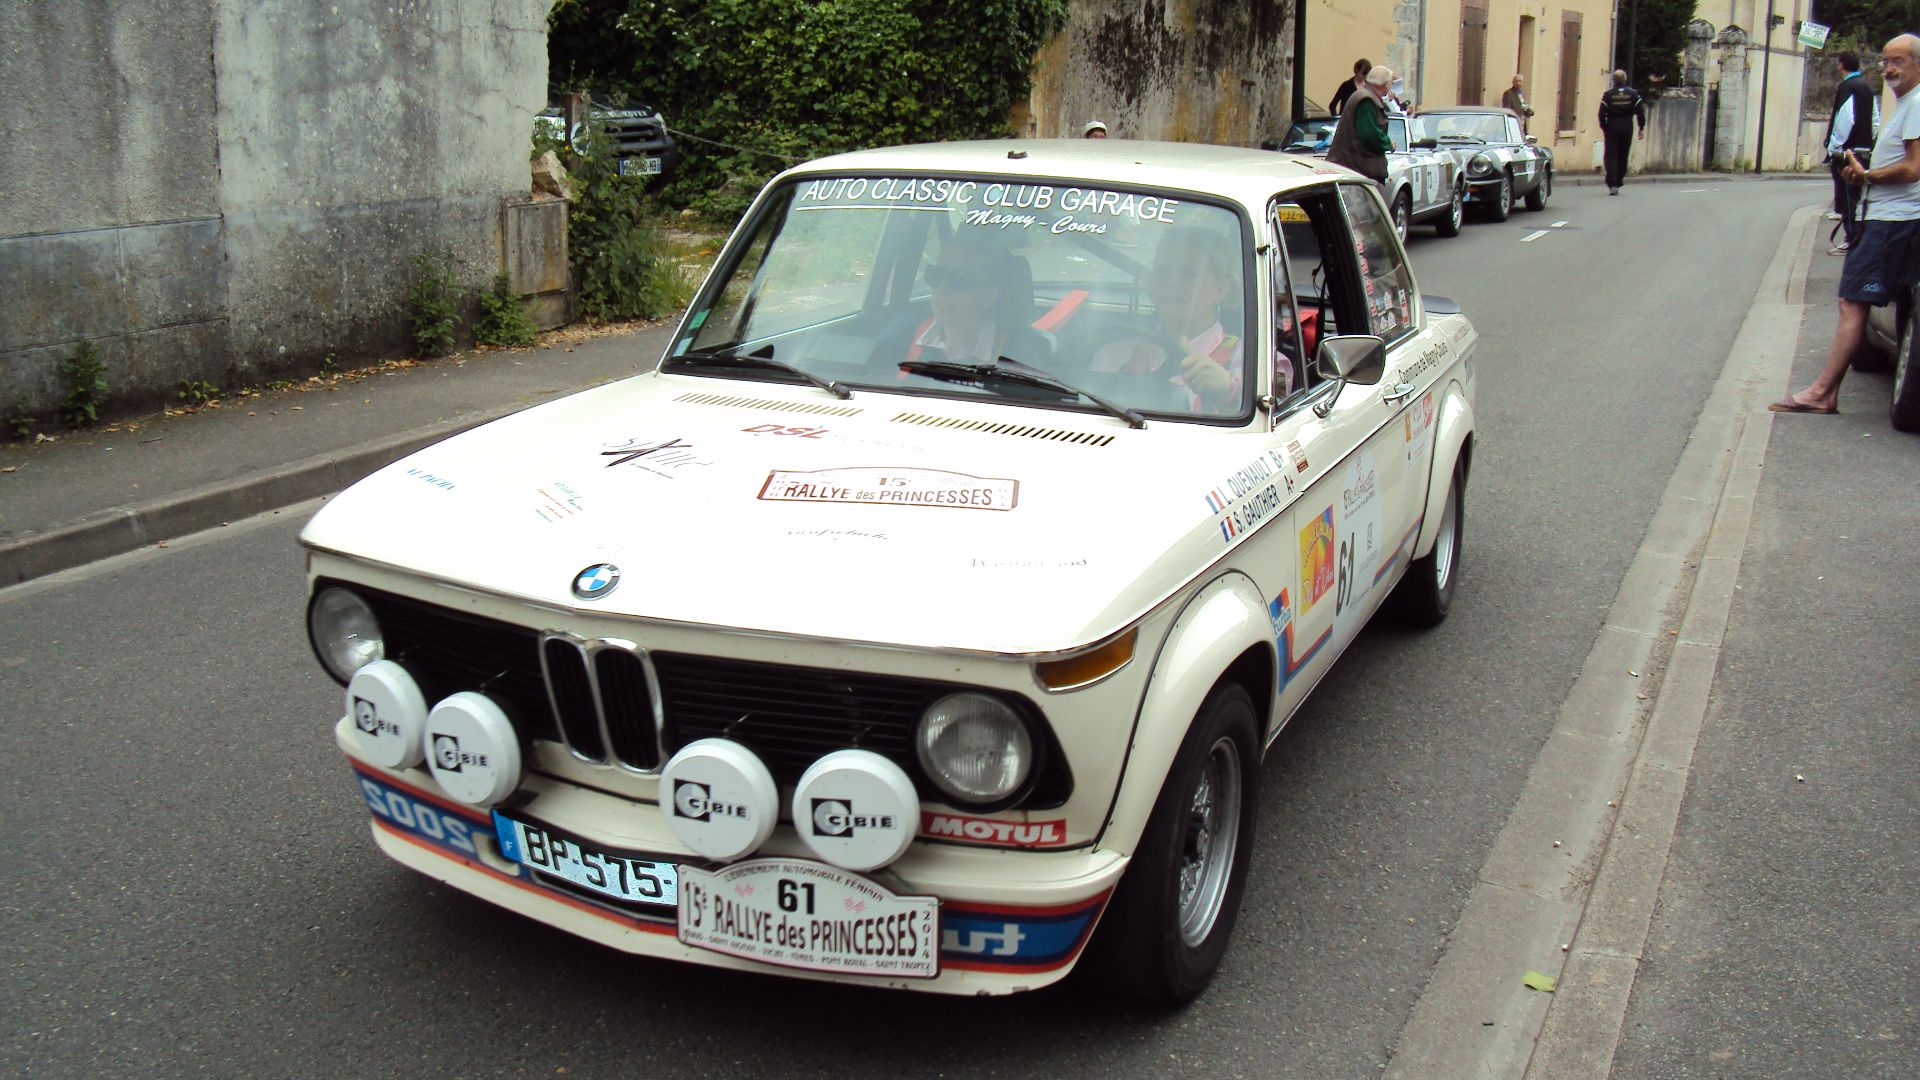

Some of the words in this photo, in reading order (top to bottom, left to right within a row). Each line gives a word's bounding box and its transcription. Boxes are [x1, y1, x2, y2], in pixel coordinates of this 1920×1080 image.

[801, 177, 868, 201] AUTO
[871, 178, 976, 204] CLASSIC
[983, 183, 1054, 209] CLUB
[1060, 187, 1179, 224] GARAGE
[965, 209, 1035, 230] Magny
[1050, 215, 1108, 235] Cours
[740, 423, 829, 439] DSL
[783, 481, 851, 500] RALLYE
[855, 490, 875, 501] des
[879, 488, 994, 506] PRINCESSES
[1242, 484, 1281, 527] GAUTHIER
[443, 749, 489, 768] CIBIE
[688, 797, 748, 819] CIBIE
[827, 813, 893, 828] CIBIE
[929, 816, 1060, 843] MOTUL
[778, 878, 815, 915] 61
[713, 894, 773, 945] RALLYE
[777, 914, 804, 950] des
[810, 909, 917, 958] PRINCESSES
[922, 909, 932, 960] 2014
